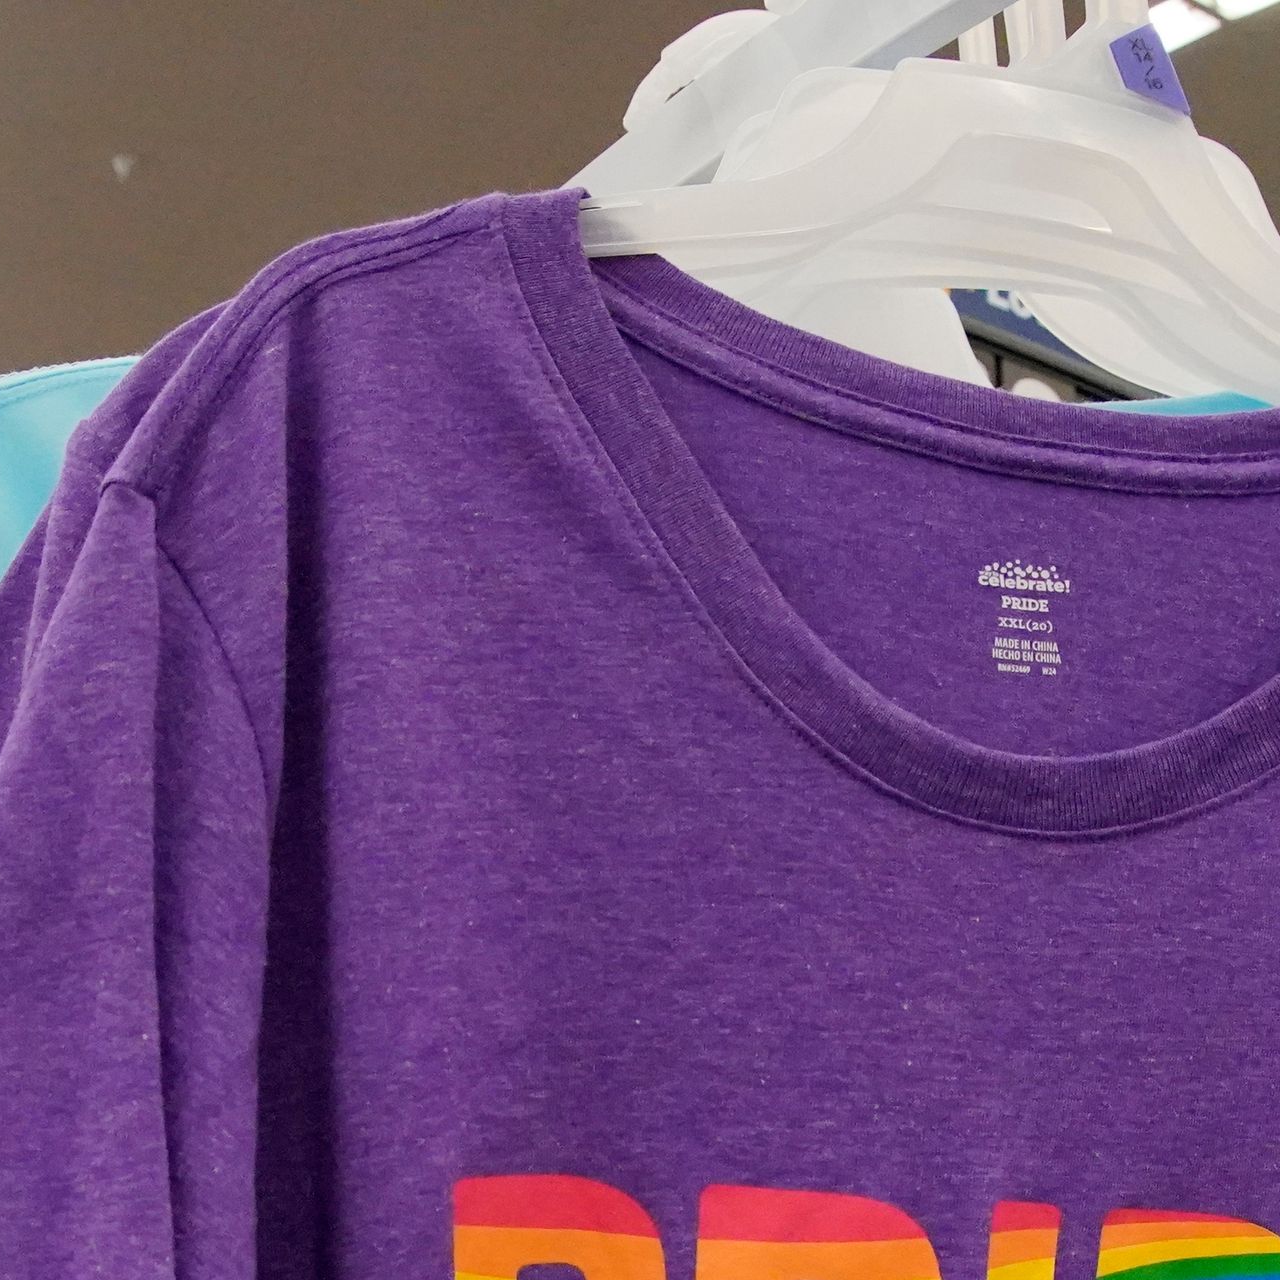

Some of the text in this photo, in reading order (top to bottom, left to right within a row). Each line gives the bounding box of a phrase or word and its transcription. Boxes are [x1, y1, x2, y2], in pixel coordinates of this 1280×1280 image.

[978, 573, 1070, 593] celebrate!
[1001, 595, 1049, 613] PRIDE
[998, 616, 1053, 634] XXL(20)
[994, 637, 1059, 653] MADE IN CHINA
[992, 648, 1062, 664] HECHO EN CHINA
